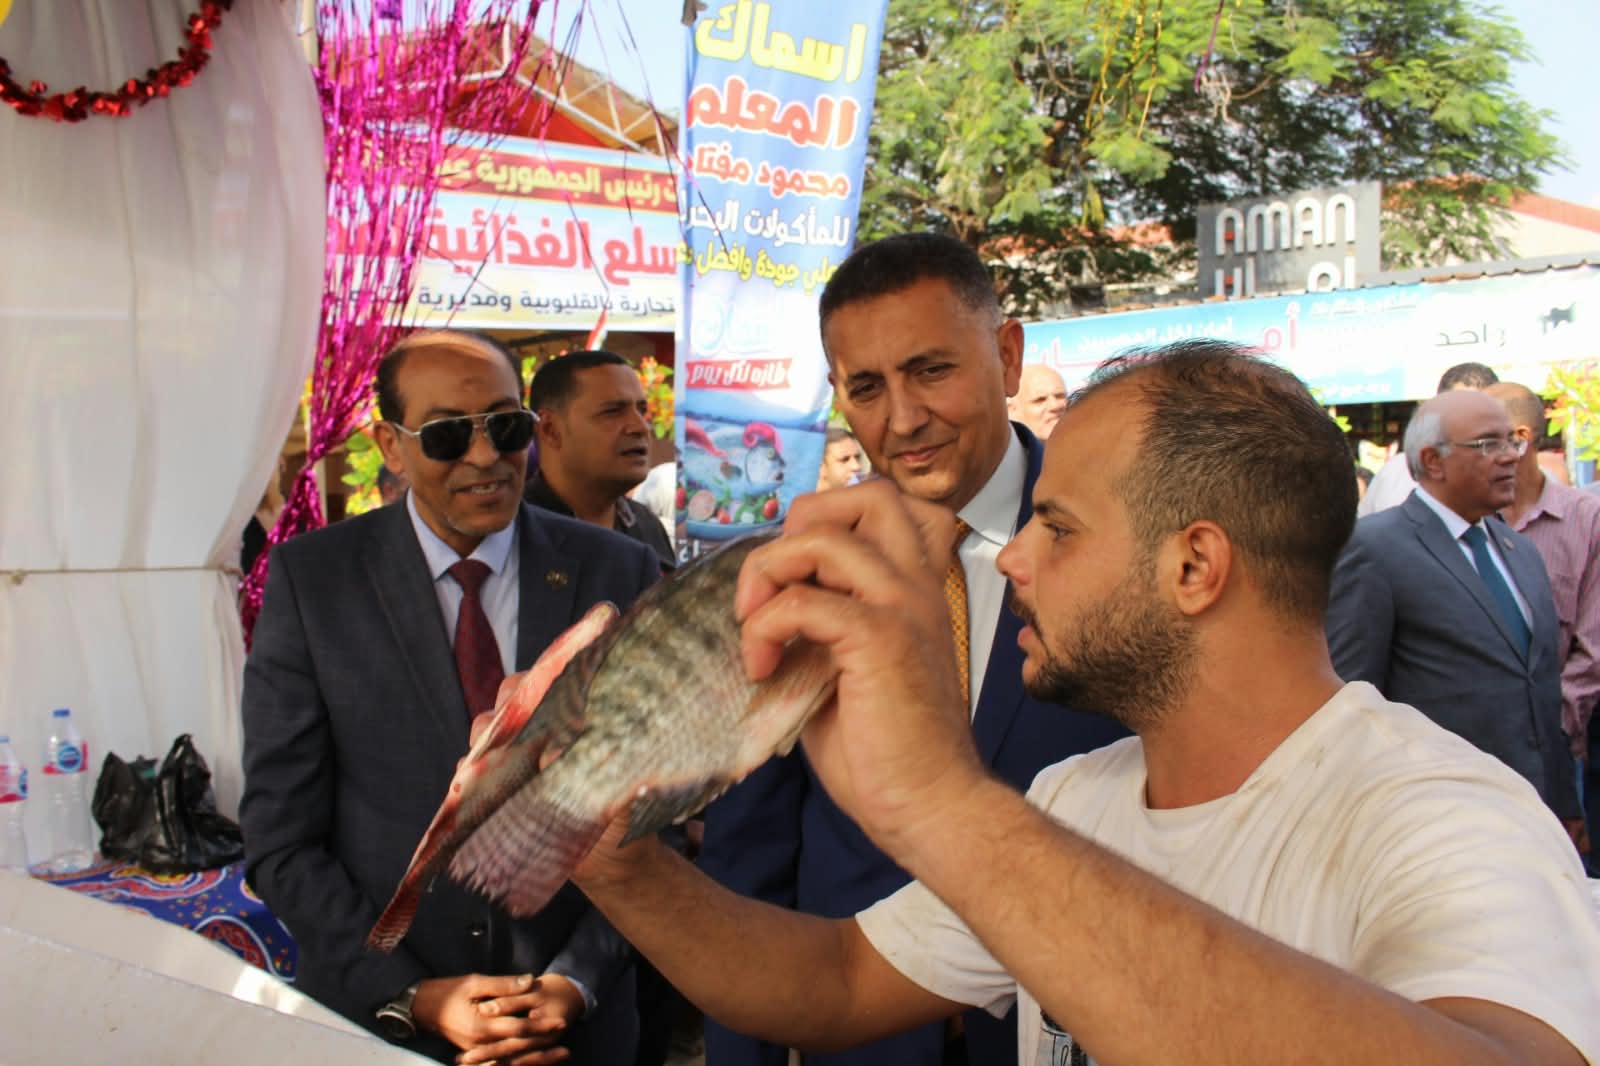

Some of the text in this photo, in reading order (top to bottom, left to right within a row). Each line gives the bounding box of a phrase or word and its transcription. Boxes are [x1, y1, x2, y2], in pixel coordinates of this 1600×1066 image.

[695, 0, 867, 83] اسماك
[687, 76, 859, 148] المعلم
[477, 154, 600, 195] الجمهورية
[604, 173, 661, 206] رئيس
[755, 161, 849, 197] محمود
[424, 207, 592, 275] الغذائية
[743, 205, 850, 247] للمأكولات
[1215, 193, 1355, 256] AMAN
[604, 226, 677, 287] سلع
[755, 249, 799, 287] جودة
[418, 286, 512, 314] ومديرية
[520, 291, 613, 315] بالقليوبية
